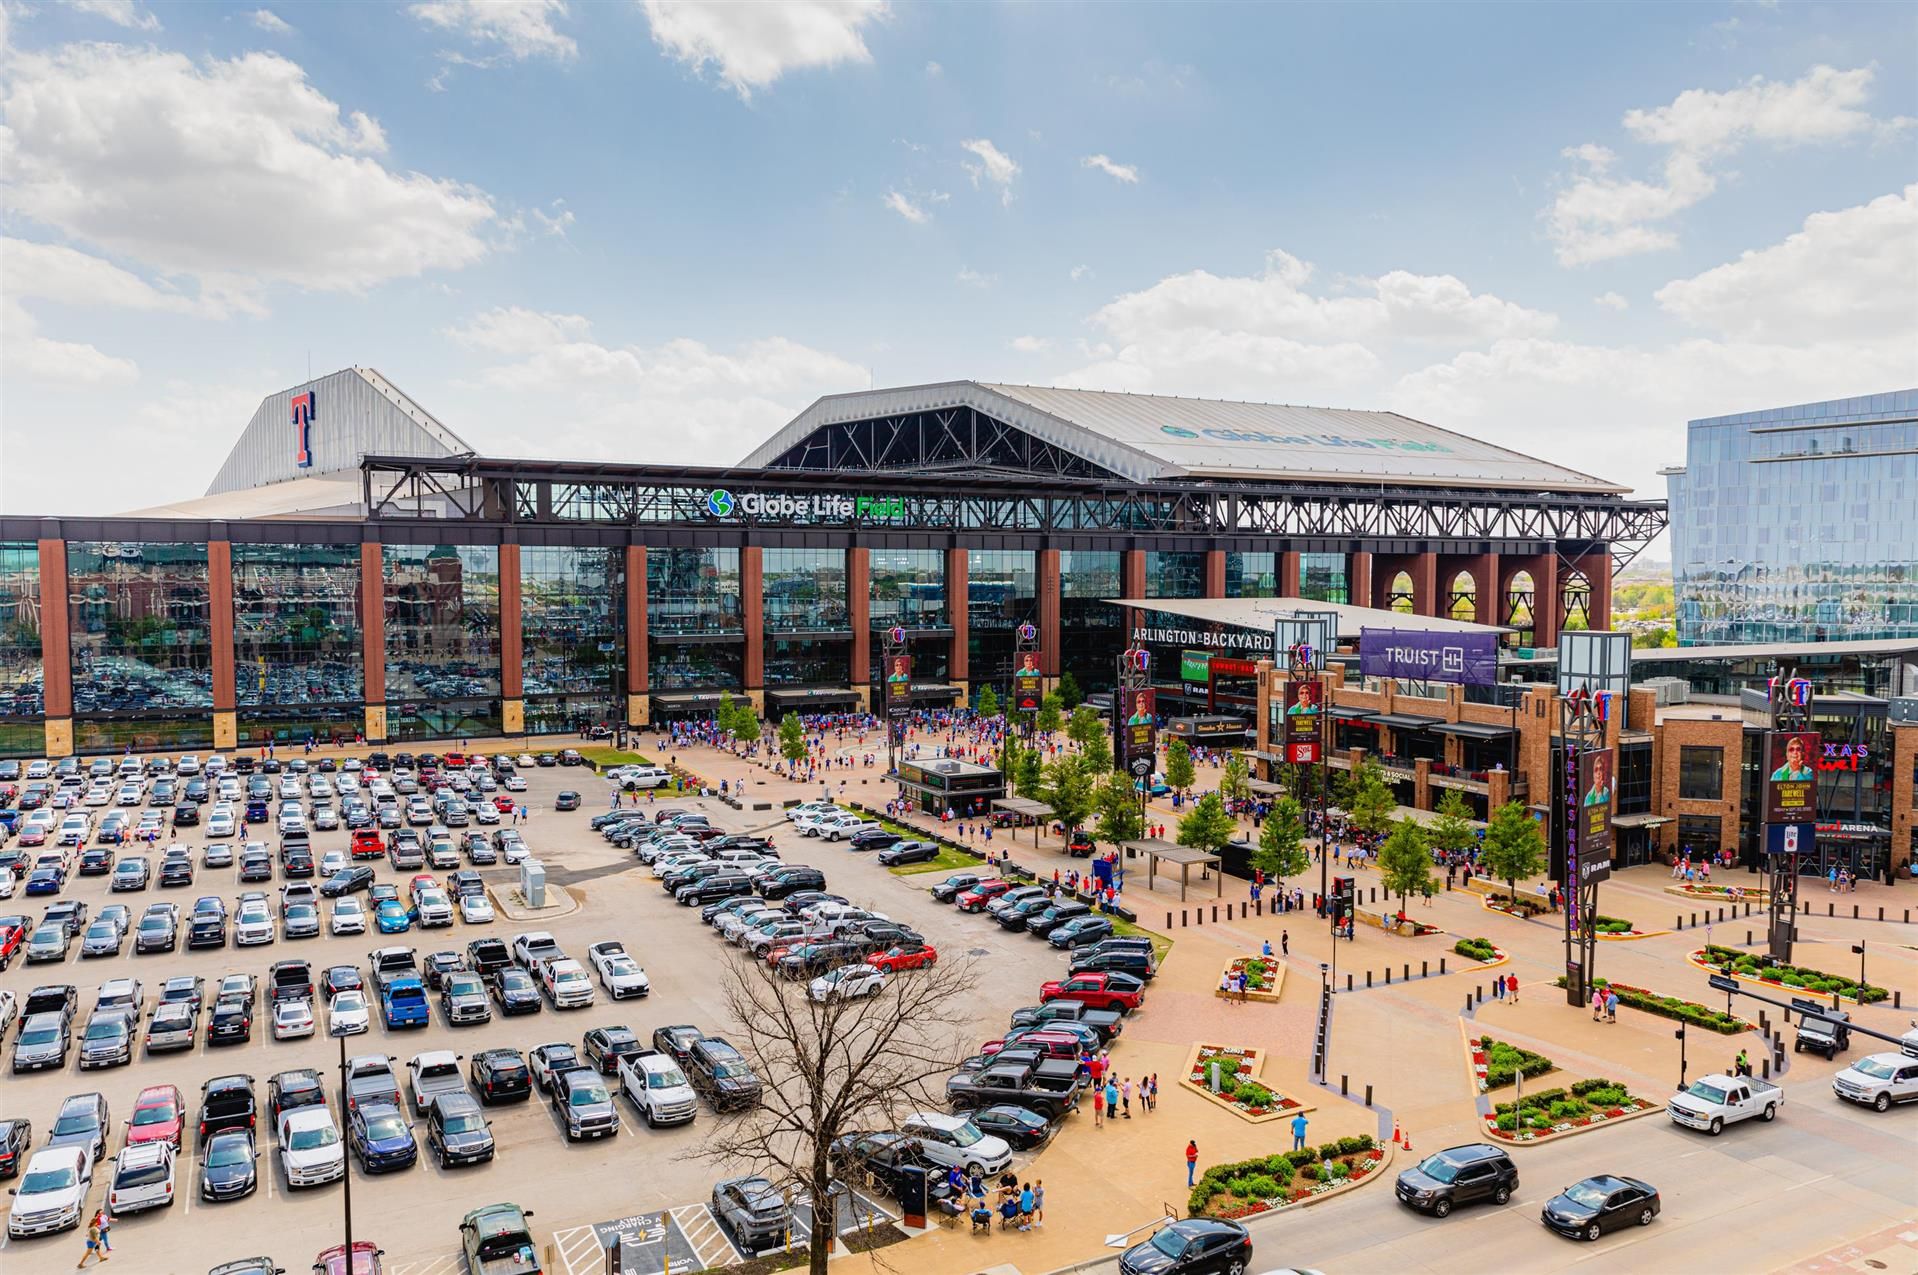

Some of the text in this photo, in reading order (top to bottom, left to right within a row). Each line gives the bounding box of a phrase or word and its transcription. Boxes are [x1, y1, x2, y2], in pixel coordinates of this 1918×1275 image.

[291, 391, 315, 467] T
[741, 493, 906, 517] Globe Life Field
[1133, 627, 1272, 650] ARLINGTON BACKYARD
[1385, 647, 1440, 666] TRUIST
[1823, 743, 1868, 758] XAS
[1392, 771, 1412, 780] SOCIAL
[1841, 824, 1878, 833] ARENA
[1590, 860, 1610, 872] RAM
[600, 1219, 652, 1234] CHARGING
